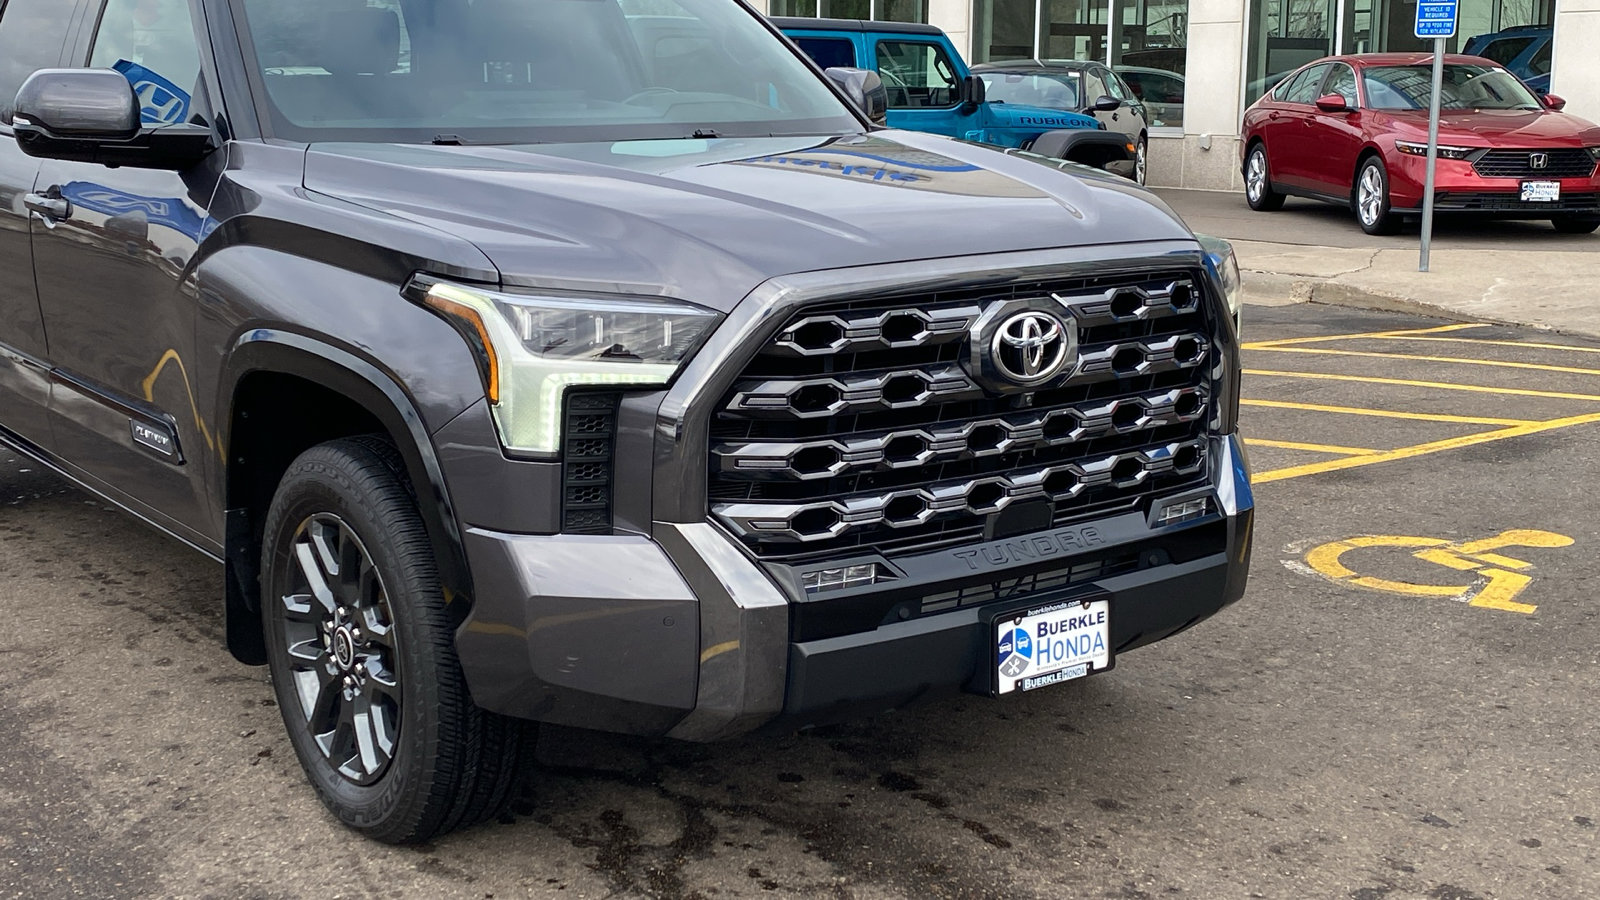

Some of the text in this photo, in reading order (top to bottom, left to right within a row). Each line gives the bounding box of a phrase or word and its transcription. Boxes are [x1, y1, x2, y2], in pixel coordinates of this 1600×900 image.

[1019, 116, 1092, 127] RUBICON
[953, 526, 1106, 570] TUNDRA
[1027, 600, 1081, 616] buerklehonda.com
[1036, 610, 1105, 638] BUERKLE
[1036, 631, 1105, 666] HONDA
[1024, 666, 1086, 689] BUERKLE HONDA
